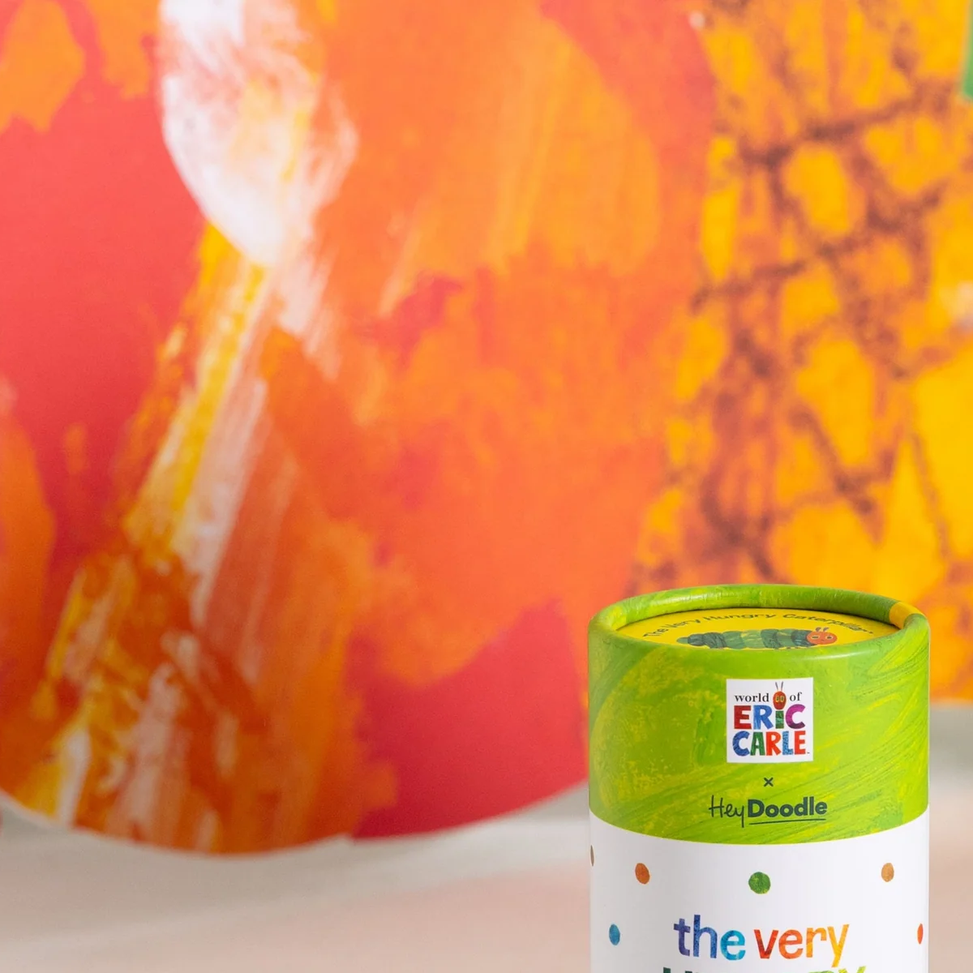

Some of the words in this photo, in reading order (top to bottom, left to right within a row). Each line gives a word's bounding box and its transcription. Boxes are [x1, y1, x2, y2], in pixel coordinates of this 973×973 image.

[734, 693, 769, 702] world
[789, 692, 803, 702] of
[732, 731, 806, 757] CARLE
[673, 914, 746, 961] the
[754, 924, 849, 967] very
